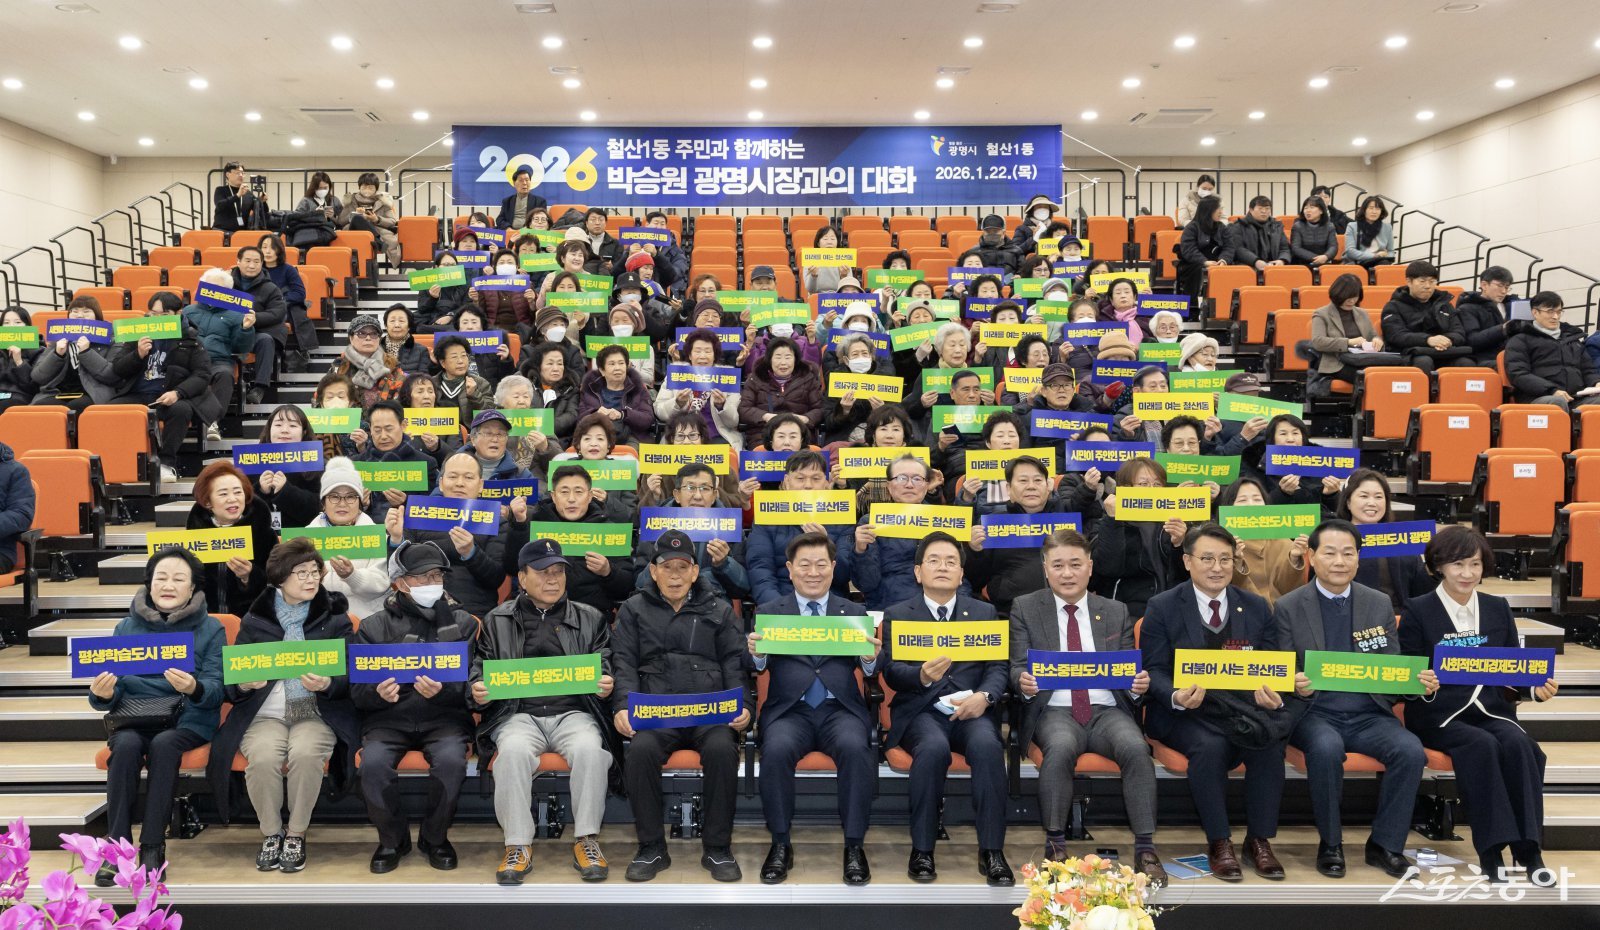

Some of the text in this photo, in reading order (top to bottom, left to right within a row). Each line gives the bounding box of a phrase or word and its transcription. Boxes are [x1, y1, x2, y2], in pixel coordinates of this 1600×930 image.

[607, 139, 805, 159] 철산1동 주민과 함께하는
[949, 143, 1034, 156] 광명시 철산1동
[475, 148, 598, 193] 2026
[935, 164, 1038, 182] 2026.1.22.(목)
[608, 166, 915, 194] 박승원 광명시장과의 대화
[671, 373, 736, 385] 평생학습도시 광명
[1096, 367, 1137, 378] 탄소중립도
[1138, 401, 1209, 411] 미래를 여는 철산1동
[1036, 418, 1088, 430] 평생학습도시
[239, 450, 318, 464] 시민이 주인인 도시 광명
[645, 454, 724, 464] 더불어 사는 철산1동
[1071, 450, 1093, 461] 시민이
[1095, 450, 1117, 461] 주인인
[1271, 455, 1354, 468] 평생학습도시 광명
[745, 460, 786, 471] 탄소중립
[845, 458, 872, 467] 더불어
[971, 460, 998, 469] 미래를
[374, 470, 422, 482] 성장도시 광명
[612, 470, 632, 480] 광명
[1167, 463, 1230, 476] 정원도시 광명
[480, 486, 533, 498] 립도시 광명
[760, 501, 850, 512] 미래를 여는 철산1동
[1122, 498, 1206, 509] 미래를 여는 철산1동
[410, 504, 494, 523] 탄소중립도시 광명
[646, 517, 736, 531] 사회적연대경제도시 광명
[875, 514, 965, 528] 더불어 사는 철산1동
[1225, 515, 1315, 528] 자원순환도시 광명
[988, 524, 1052, 536] 평생학습도시
[325, 536, 360, 549] 성장도시
[362, 535, 380, 548] 광명
[604, 534, 626, 545] 광명
[1410, 531, 1431, 543] 광명
[188, 538, 246, 552] 사는 철산1동
[762, 628, 867, 642] 자원순환도시 광명
[899, 634, 1001, 647] 미래를 여는 철산1동
[79, 645, 187, 663] 평생학습도시 광명
[230, 651, 338, 670] 지속가능 성장도시 광명
[356, 655, 460, 670] 평생학습도시 광명
[1440, 658, 1548, 674] 사회적연대경제도시 광명
[490, 666, 594, 686] 지속가능 성장도시 광명
[1032, 662, 1137, 677] 탄소중립도시 광명
[1182, 663, 1287, 677] 더불어 사는 철산1동
[1321, 664, 1410, 681] 정원도시 광명
[633, 699, 737, 718] 사회적연대경제도시 광명
